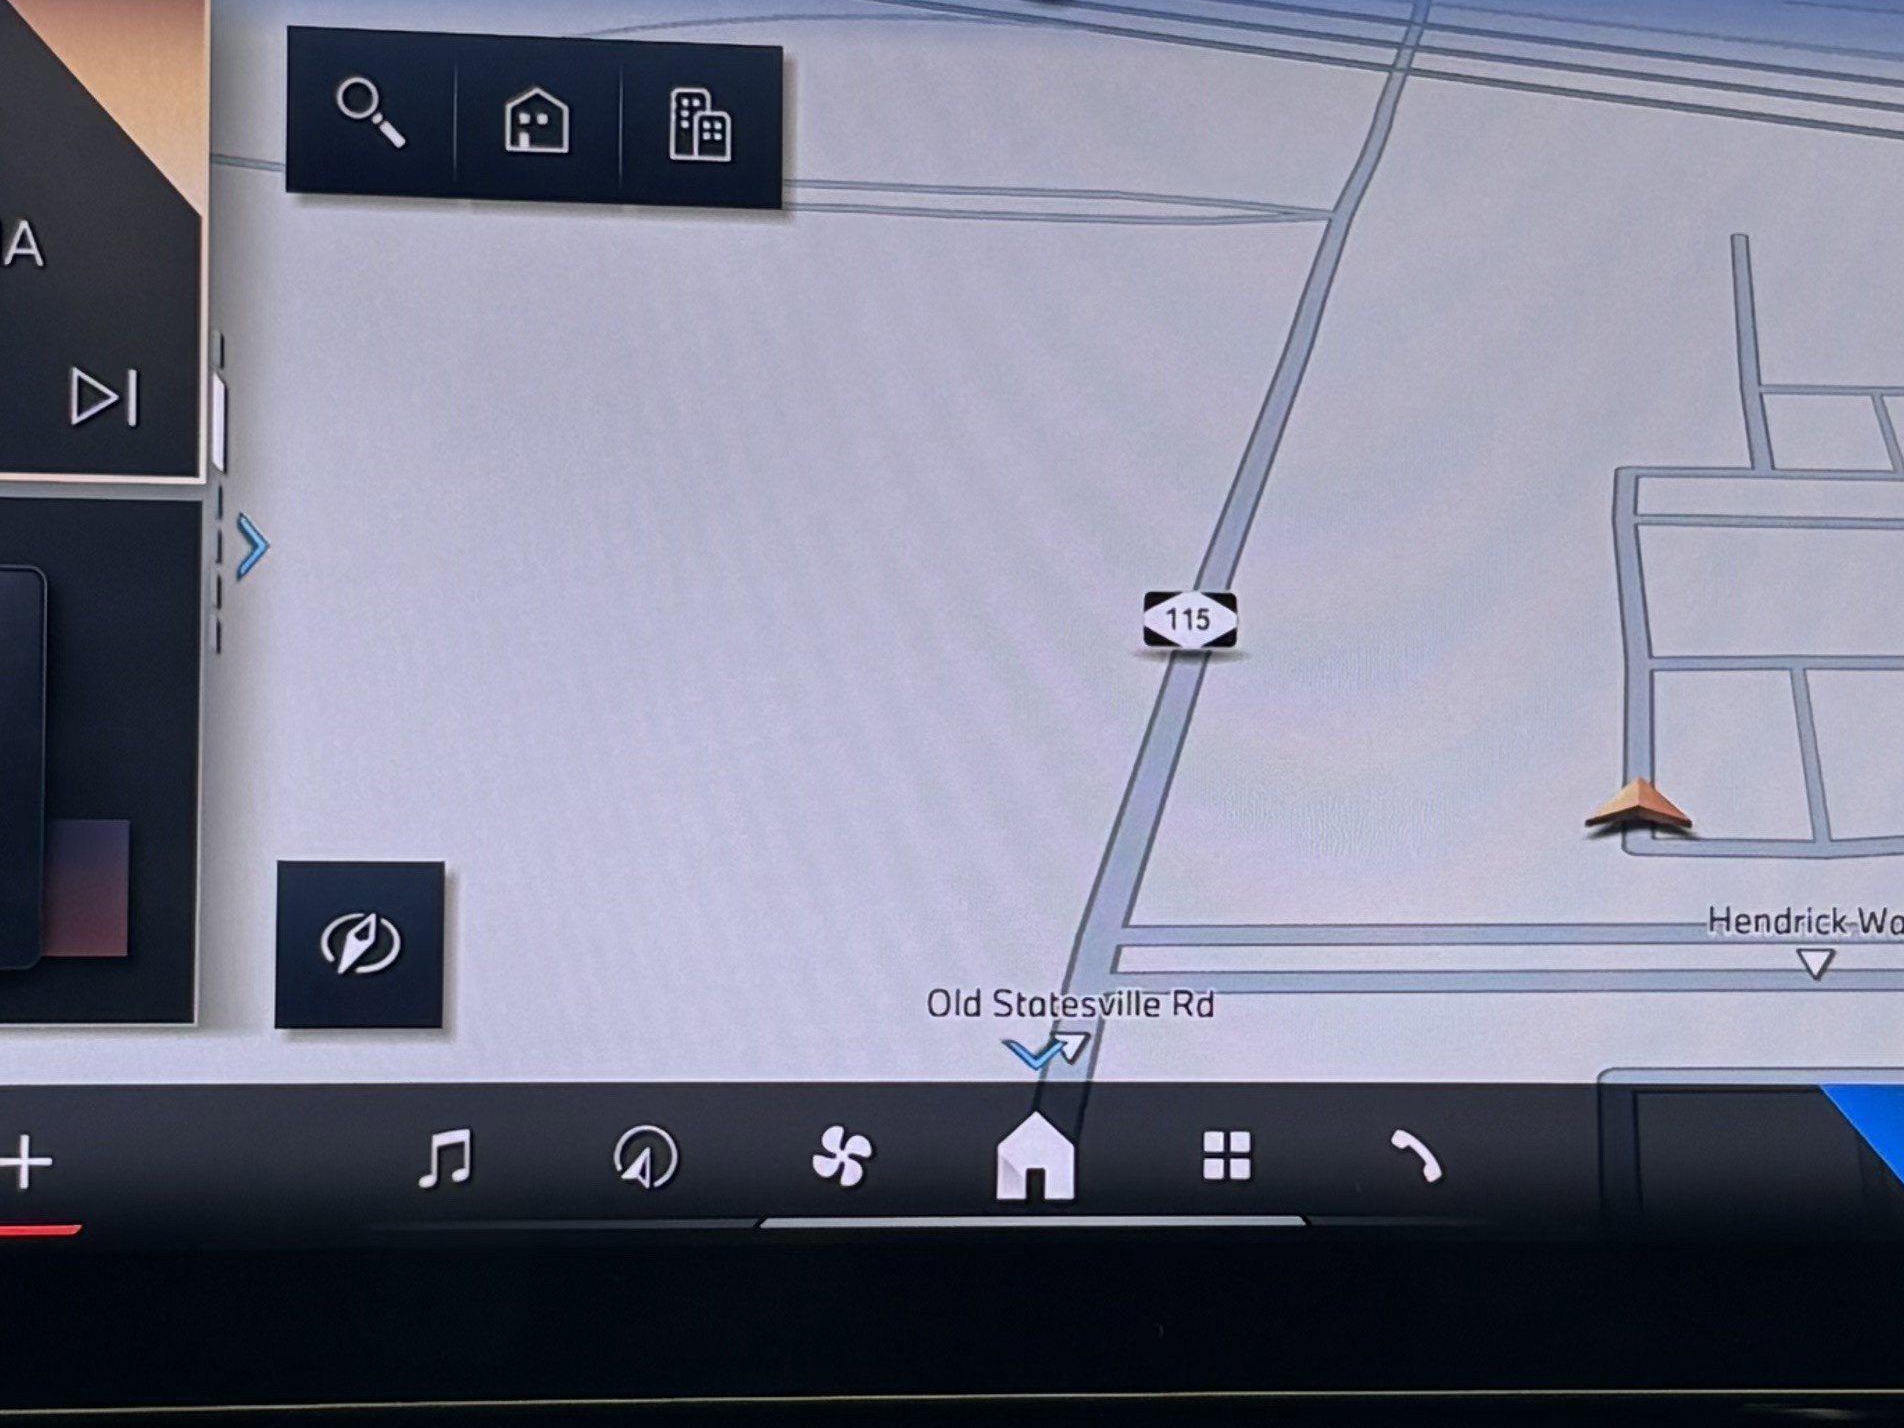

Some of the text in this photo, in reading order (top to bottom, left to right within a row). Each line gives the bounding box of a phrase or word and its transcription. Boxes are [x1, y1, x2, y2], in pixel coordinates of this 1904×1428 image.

[1166, 607, 1211, 631] 115
[1708, 906, 1848, 935] Hendrick
[927, 987, 1215, 1018] Old Statesville Rd
